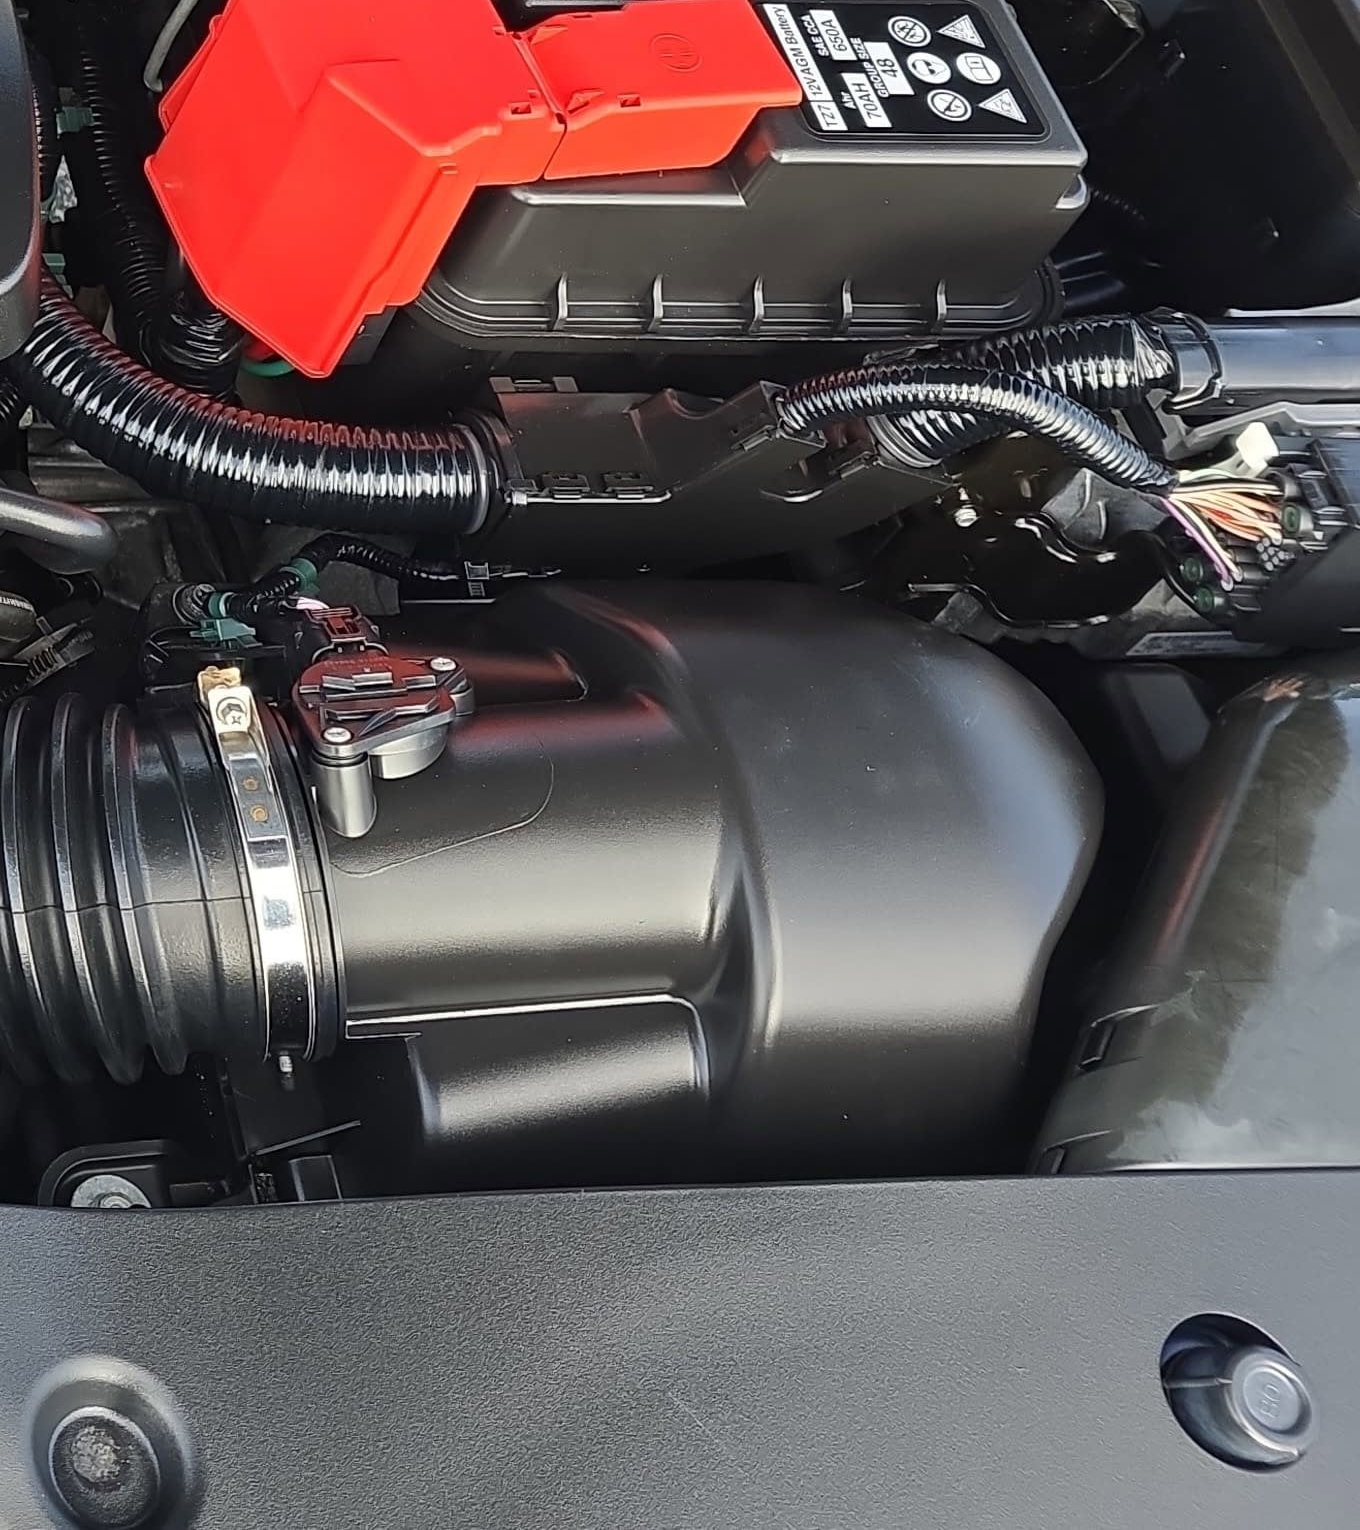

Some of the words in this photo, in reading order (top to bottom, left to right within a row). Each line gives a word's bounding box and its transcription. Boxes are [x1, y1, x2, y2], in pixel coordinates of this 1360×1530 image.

[772, 6, 798, 44] Battery
[801, 15, 818, 35] CCA
[821, 19, 848, 52] 650A
[812, 36, 829, 56] SAE
[850, 37, 870, 60] SIZE
[790, 47, 812, 75] AGM
[878, 58, 898, 78] 48
[806, 77, 823, 96] 12V
[863, 62, 889, 97] GROUP
[855, 83, 882, 119] 70AH
[819, 105, 838, 127] TZ7
